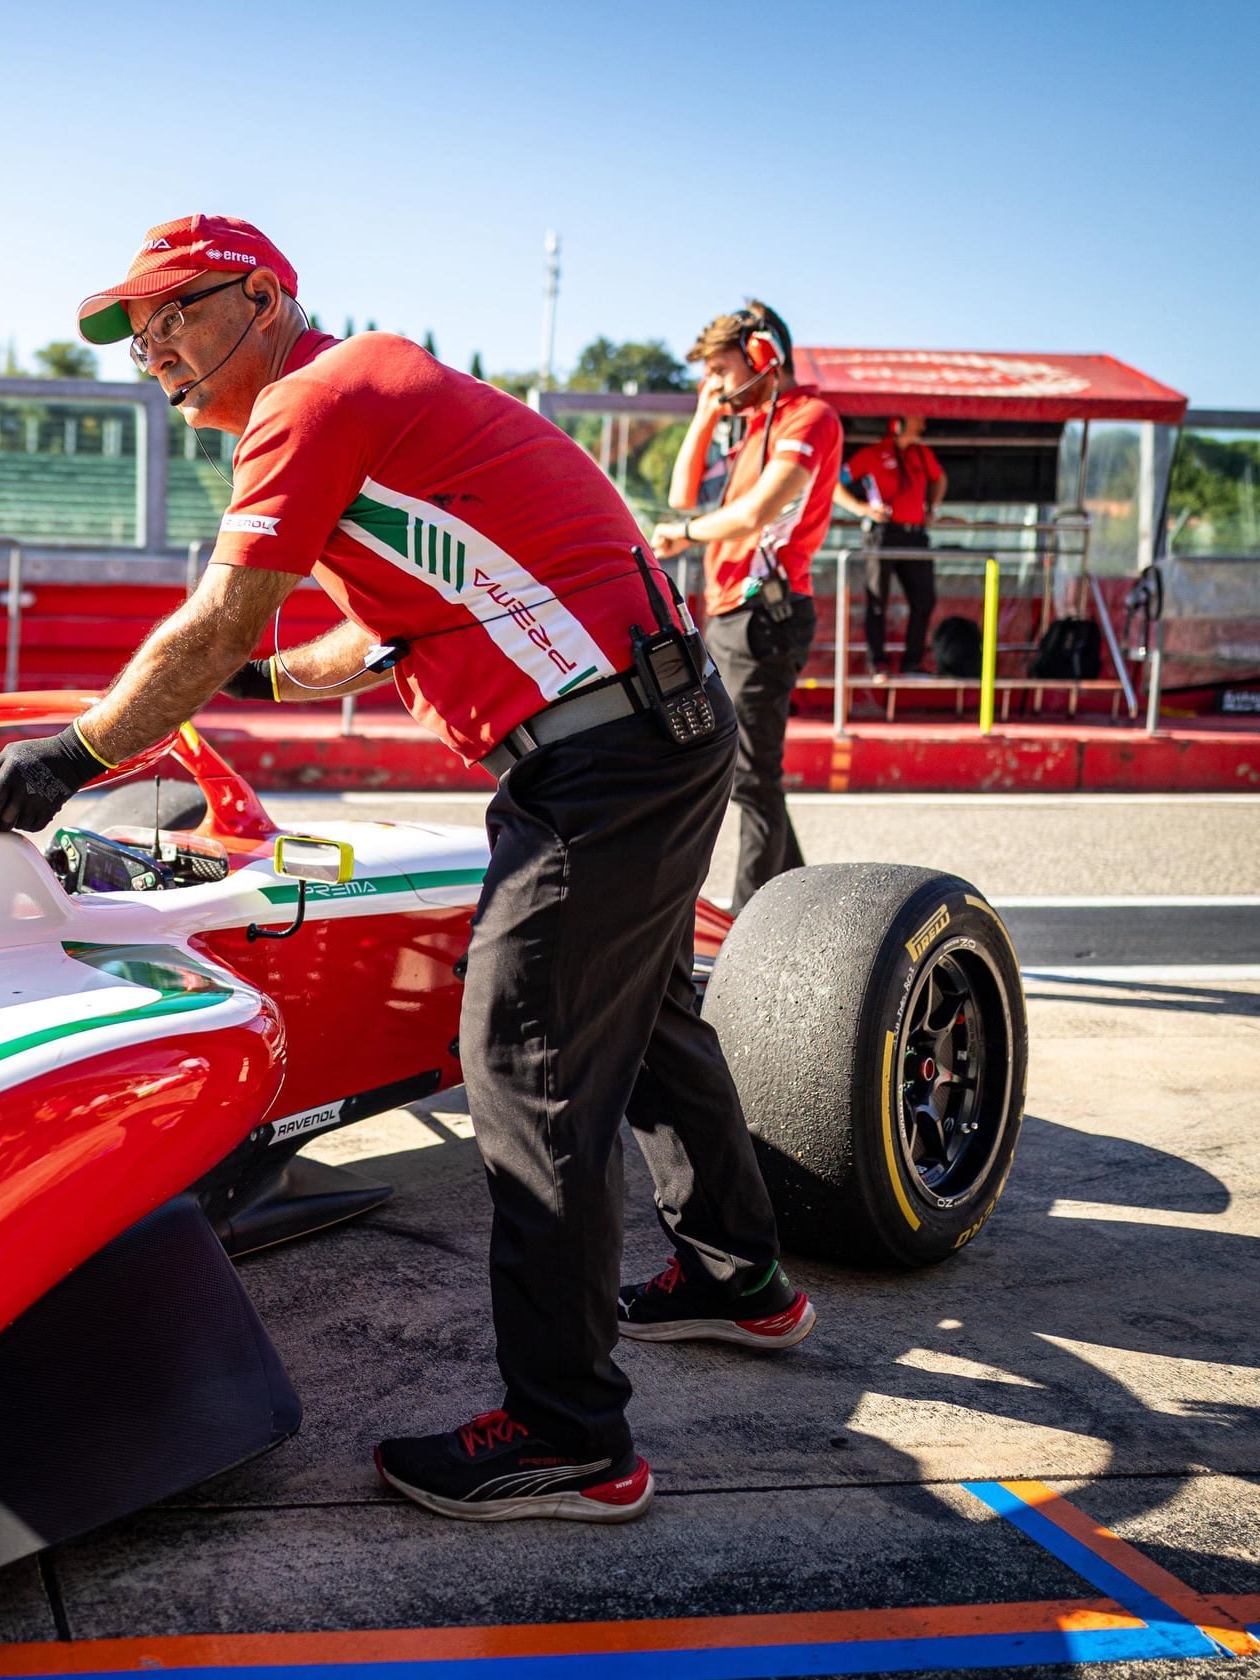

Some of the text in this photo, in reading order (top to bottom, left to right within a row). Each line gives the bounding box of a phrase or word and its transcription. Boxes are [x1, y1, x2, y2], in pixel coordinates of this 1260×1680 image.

[224, 250, 257, 266] errea
[474, 568, 577, 675] PREMA
[297, 881, 378, 897] PREMA
[905, 904, 951, 963] PIRELLI
[277, 1109, 337, 1137] RAVENOL
[937, 1198, 954, 1208] OZ
